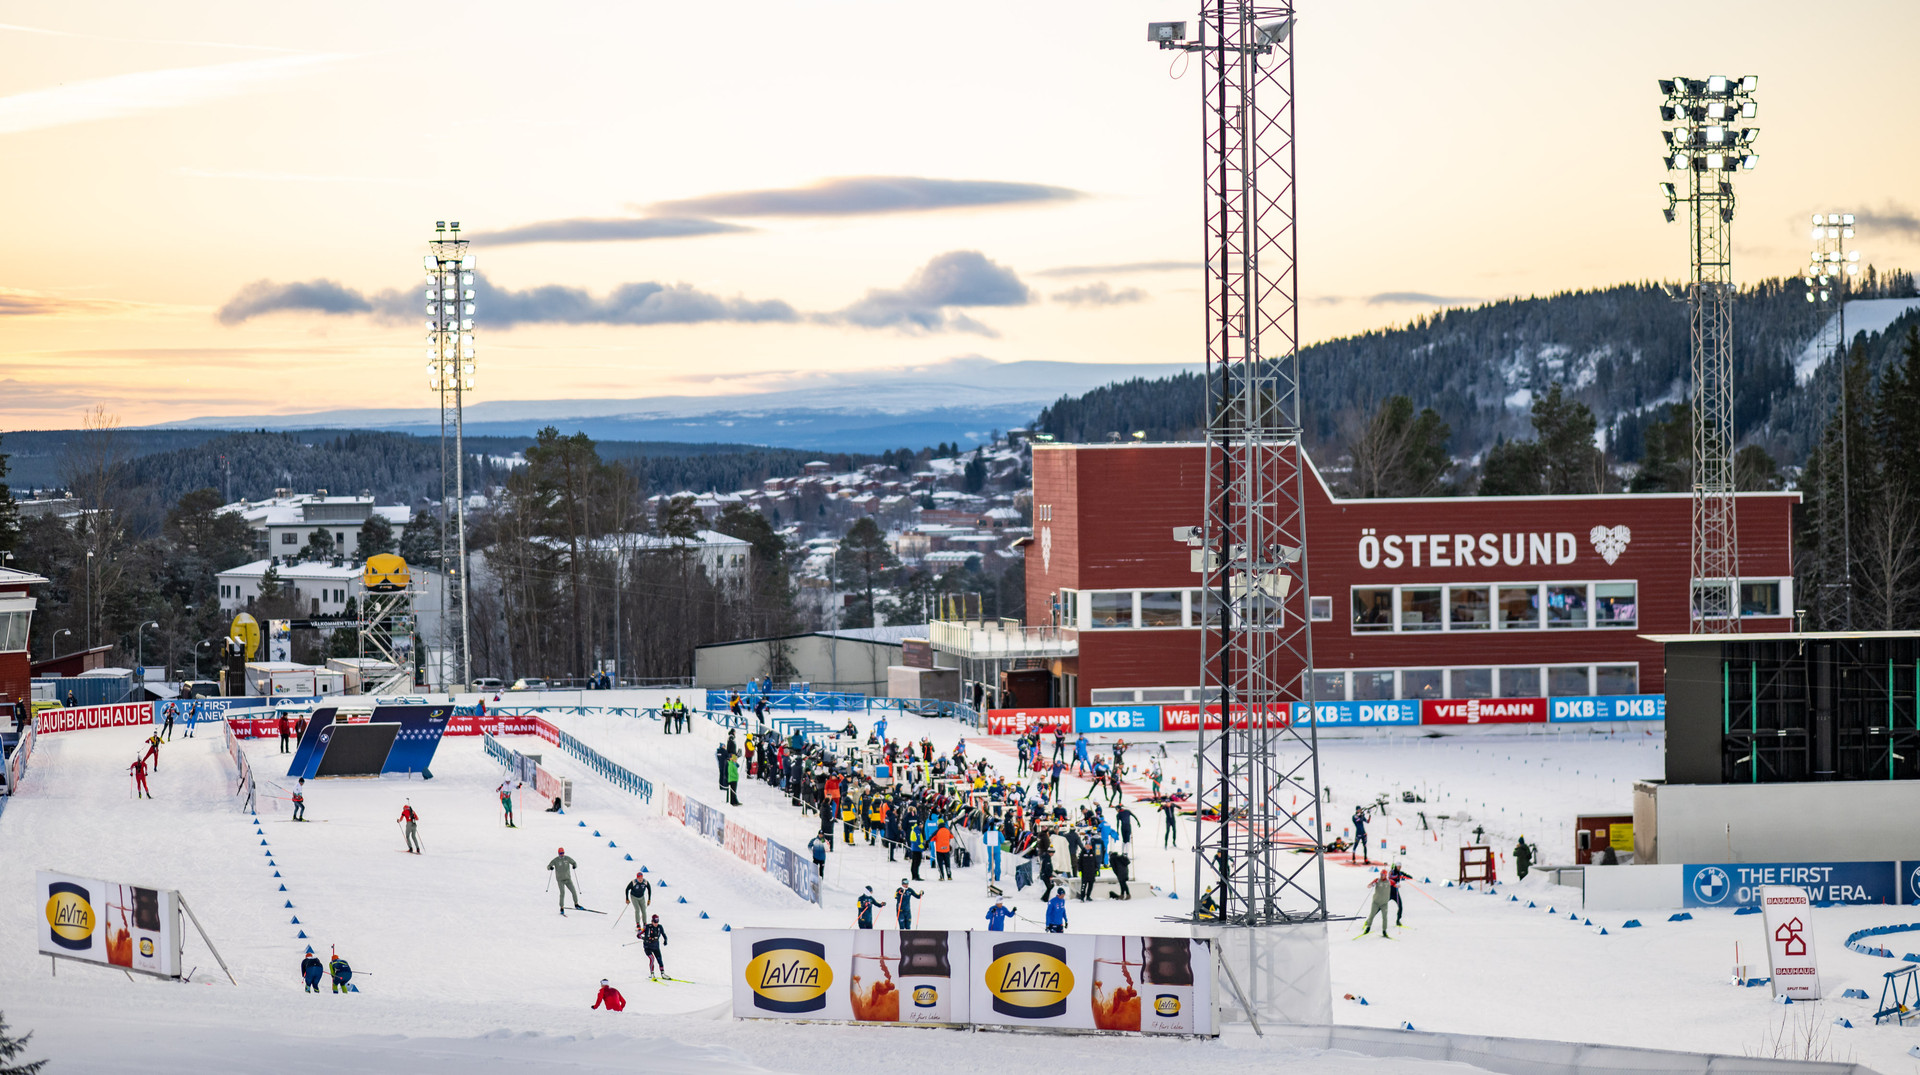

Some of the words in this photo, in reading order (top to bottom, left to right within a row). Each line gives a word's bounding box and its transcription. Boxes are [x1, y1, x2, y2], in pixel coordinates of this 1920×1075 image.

[1359, 528, 1577, 569] ÖSTERSUND
[204, 701, 232, 710] FIRST
[1360, 705, 1399, 721] DKB
[1435, 700, 1534, 723] VIESSMANN
[1555, 701, 1595, 718] DKB
[1616, 700, 1656, 717] DKB
[66, 706, 151, 728] BAUHAUS
[1090, 711, 1131, 728] DKB
[1298, 706, 1338, 723] DKB
[1738, 869, 1775, 883] THE
[1780, 867, 1833, 882] FIRST
[1829, 885, 1871, 900] ERA.
